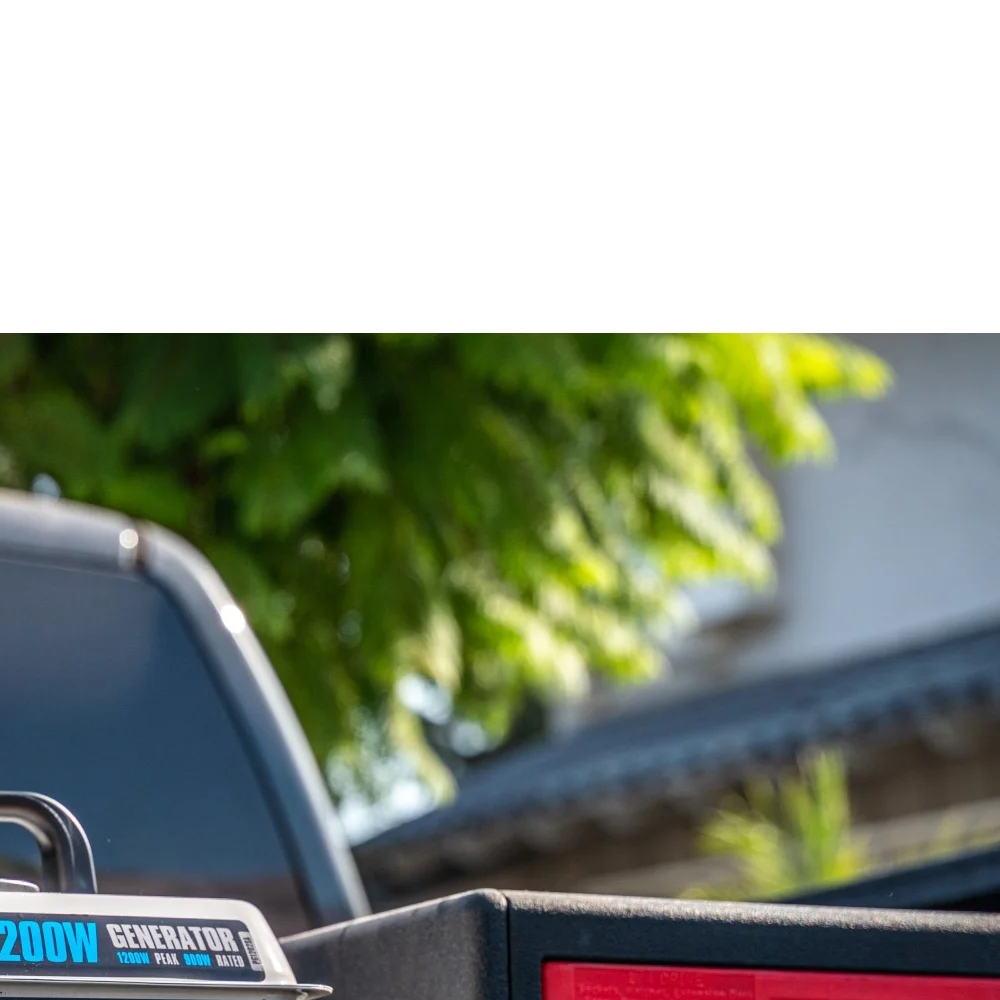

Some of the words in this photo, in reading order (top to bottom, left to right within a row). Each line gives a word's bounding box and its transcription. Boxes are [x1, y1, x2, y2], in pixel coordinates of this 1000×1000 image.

[106, 923, 239, 952] GENERATOR
[117, 951, 150, 964] 1200W
[154, 952, 180, 966] PEAK
[183, 953, 212, 967] 900W
[215, 954, 245, 968] RATED
